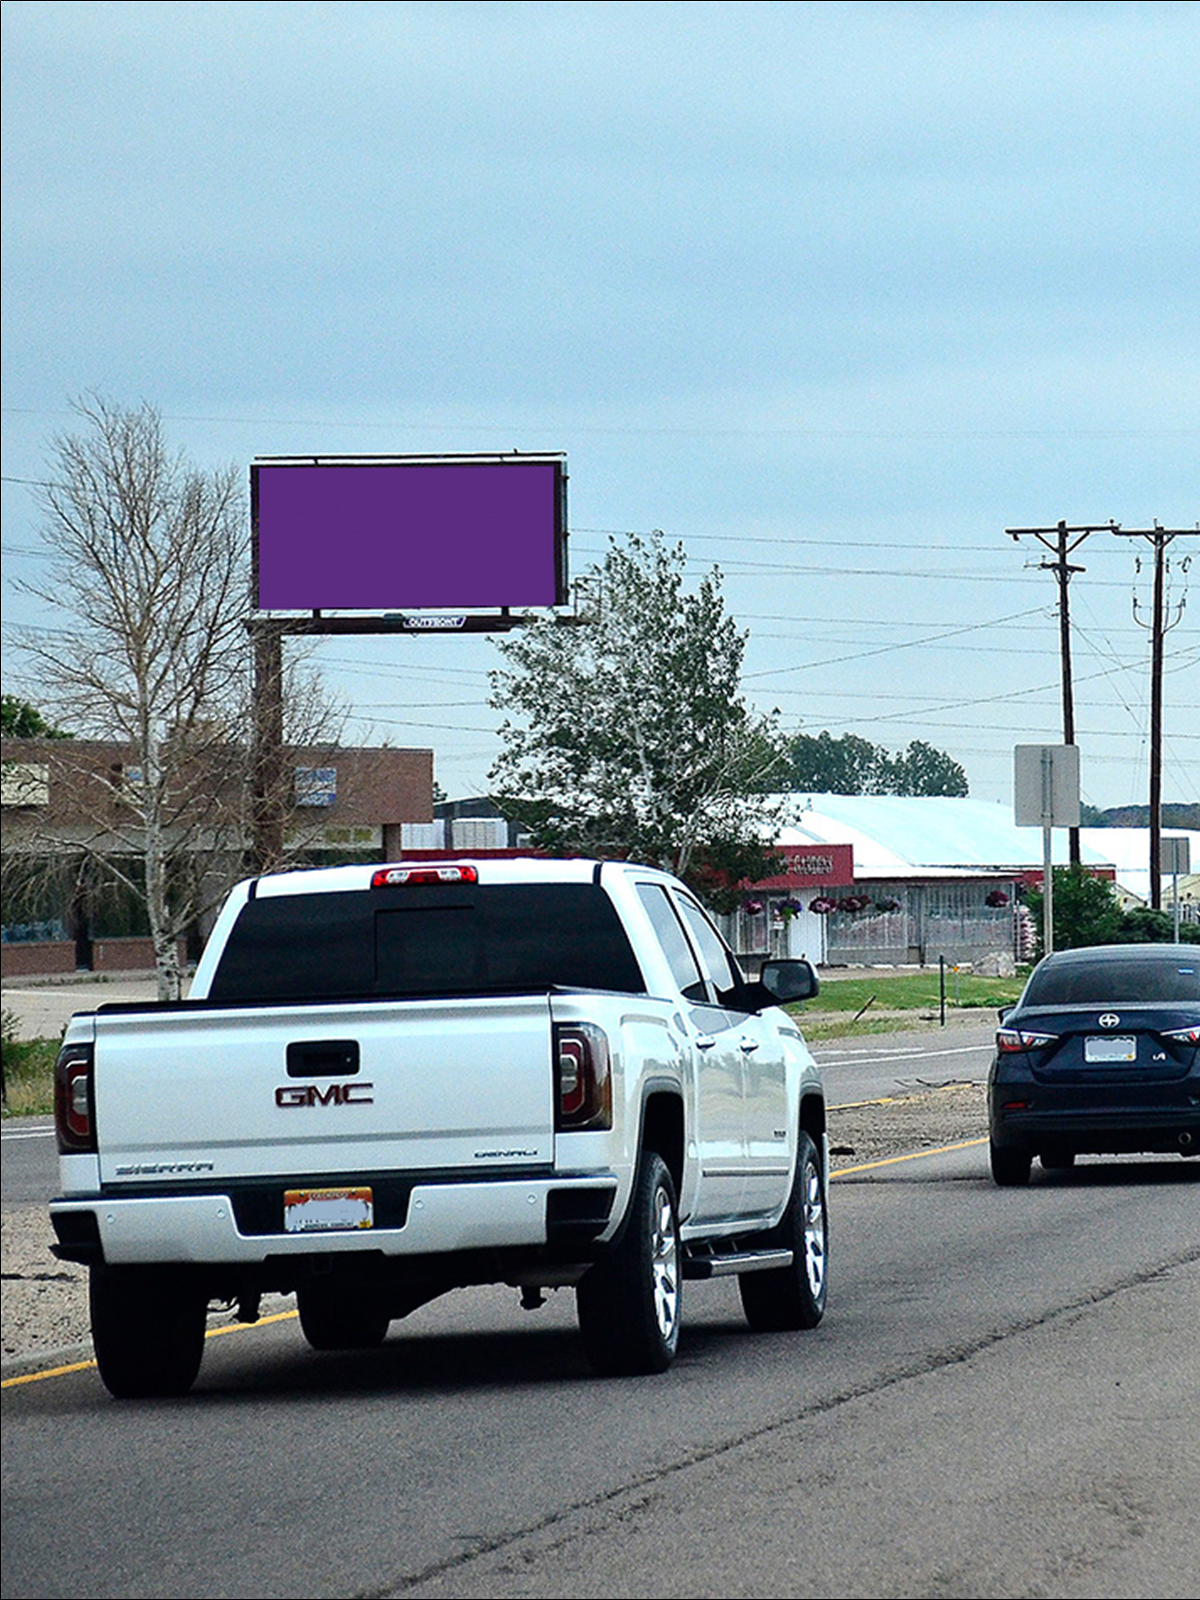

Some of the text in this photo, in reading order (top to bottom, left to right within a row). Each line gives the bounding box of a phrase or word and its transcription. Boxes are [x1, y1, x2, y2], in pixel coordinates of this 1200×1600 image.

[275, 1082, 374, 1107] GMC
[474, 1147, 538, 1159] DENALI
[115, 1160, 215, 1176] SIERRA
